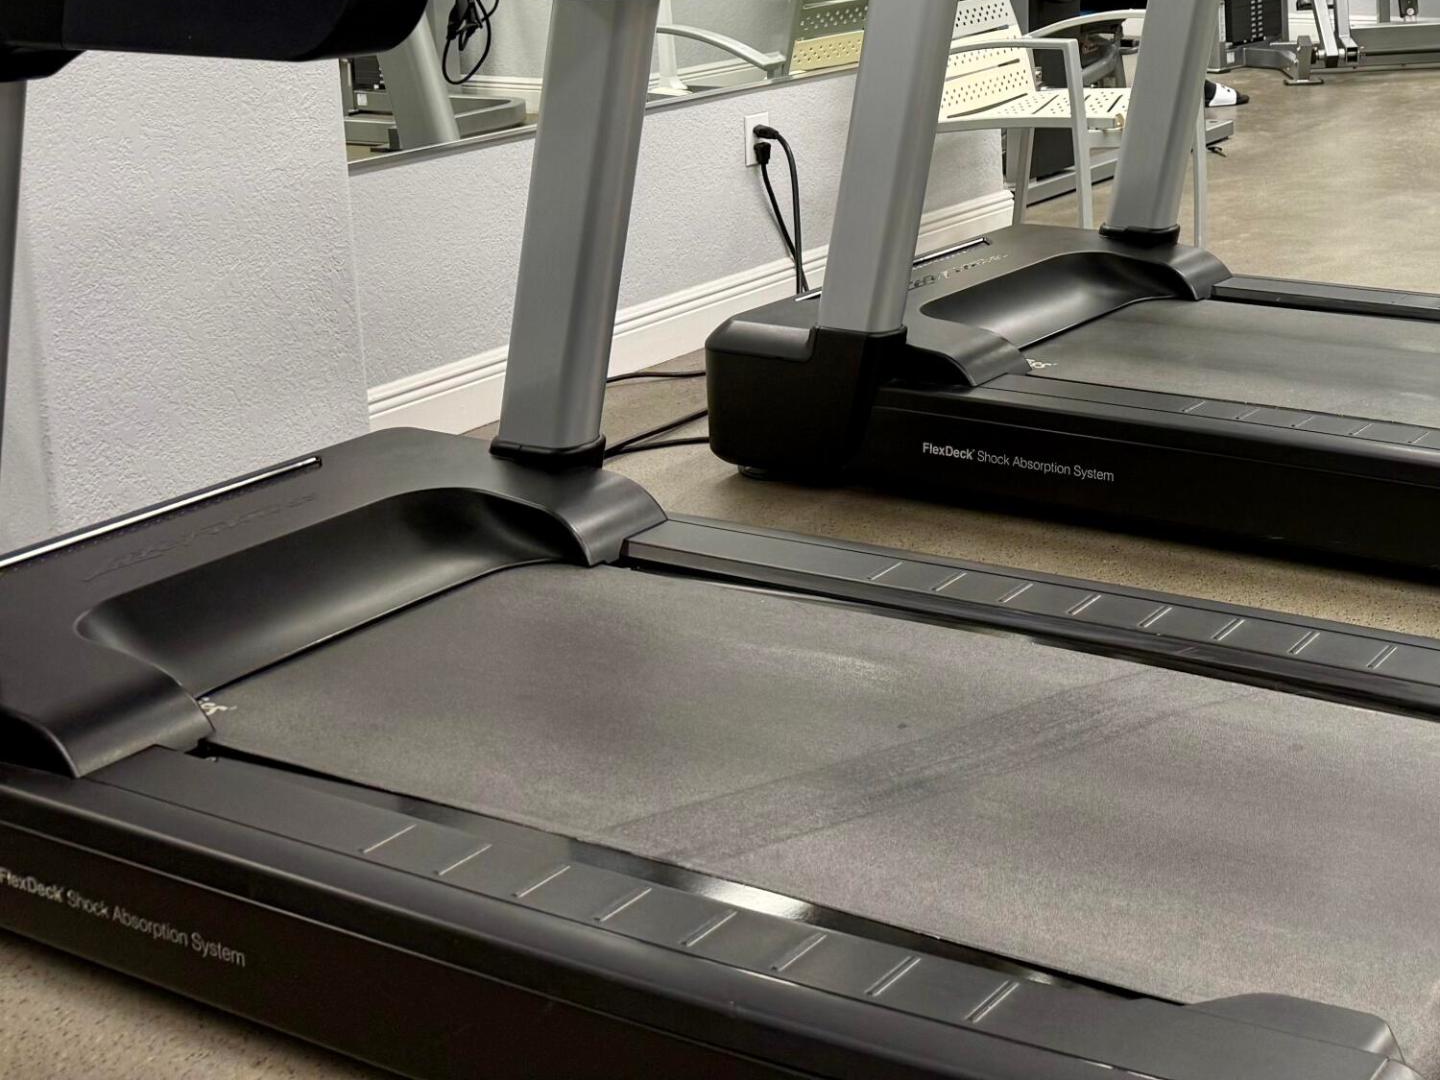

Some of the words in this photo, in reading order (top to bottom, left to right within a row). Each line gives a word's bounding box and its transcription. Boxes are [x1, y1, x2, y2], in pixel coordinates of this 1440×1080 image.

[922, 442, 974, 461] FlexDeck
[977, 451, 1010, 466] Shock
[1012, 456, 1071, 475] Absorption
[1073, 465, 1115, 482] System
[66, 889, 110, 919] Shock
[112, 905, 188, 946] Absorption
[191, 931, 246, 967] System
